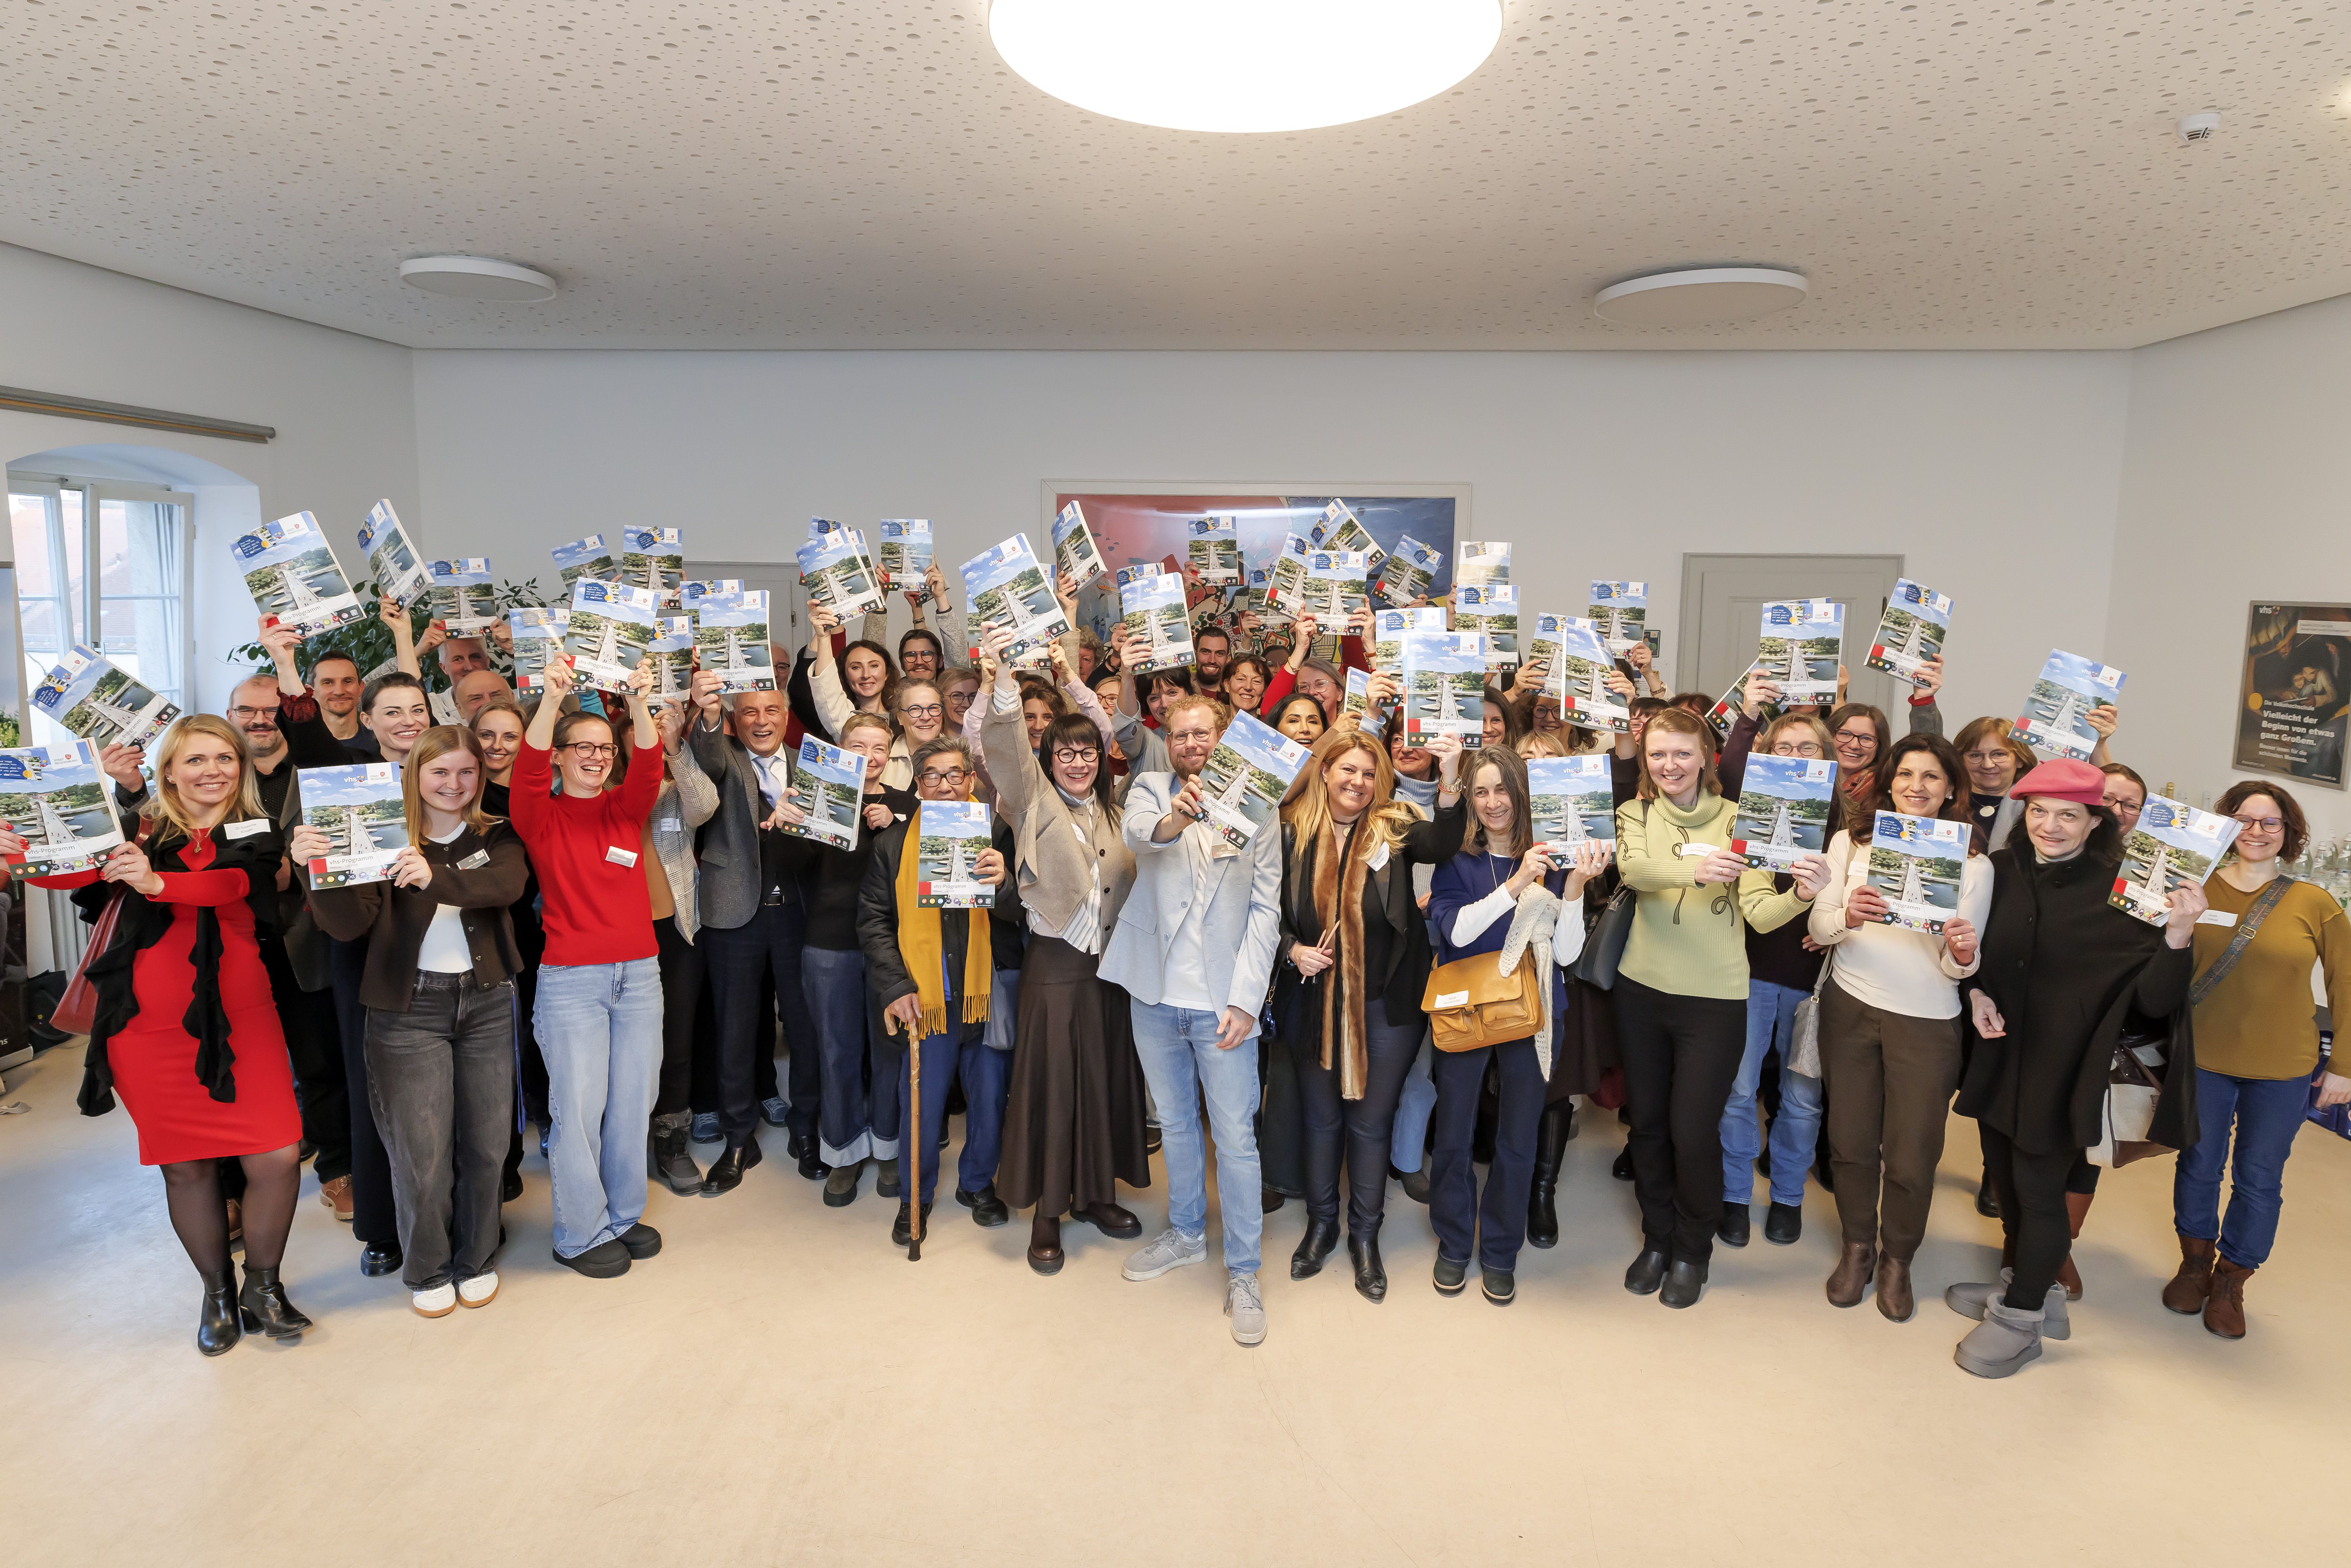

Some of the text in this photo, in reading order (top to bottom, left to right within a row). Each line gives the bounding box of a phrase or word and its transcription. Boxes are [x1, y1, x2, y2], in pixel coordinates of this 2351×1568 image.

[988, 558, 999, 567] vhs
[1278, 593, 1299, 604] vhs-Programm
[281, 606, 321, 622] vhs-Programm
[2259, 606, 2272, 614] vhs
[1885, 650, 1914, 663] vhs-Programm
[577, 659, 613, 671] vhs-Programm
[1577, 701, 1605, 710] vhs-Programm
[2263, 710, 2319, 724] Vielleicht der
[116, 719, 142, 743] hs-Programm
[2032, 724, 2066, 738] vhs-Programm
[2261, 720, 2290, 731] Beginn
[2308, 728, 2336, 738] etwas
[1262, 738, 1273, 748] vhs
[2281, 734, 2317, 746] Großem.
[1203, 797, 1230, 815] hs-Programm
[27, 845, 75, 855] vhs-Programm
[1749, 844, 1789, 854] vhs-Programm
[329, 856, 373, 865] vhs-Programm
[2128, 886, 2158, 902] vhs-Programm
